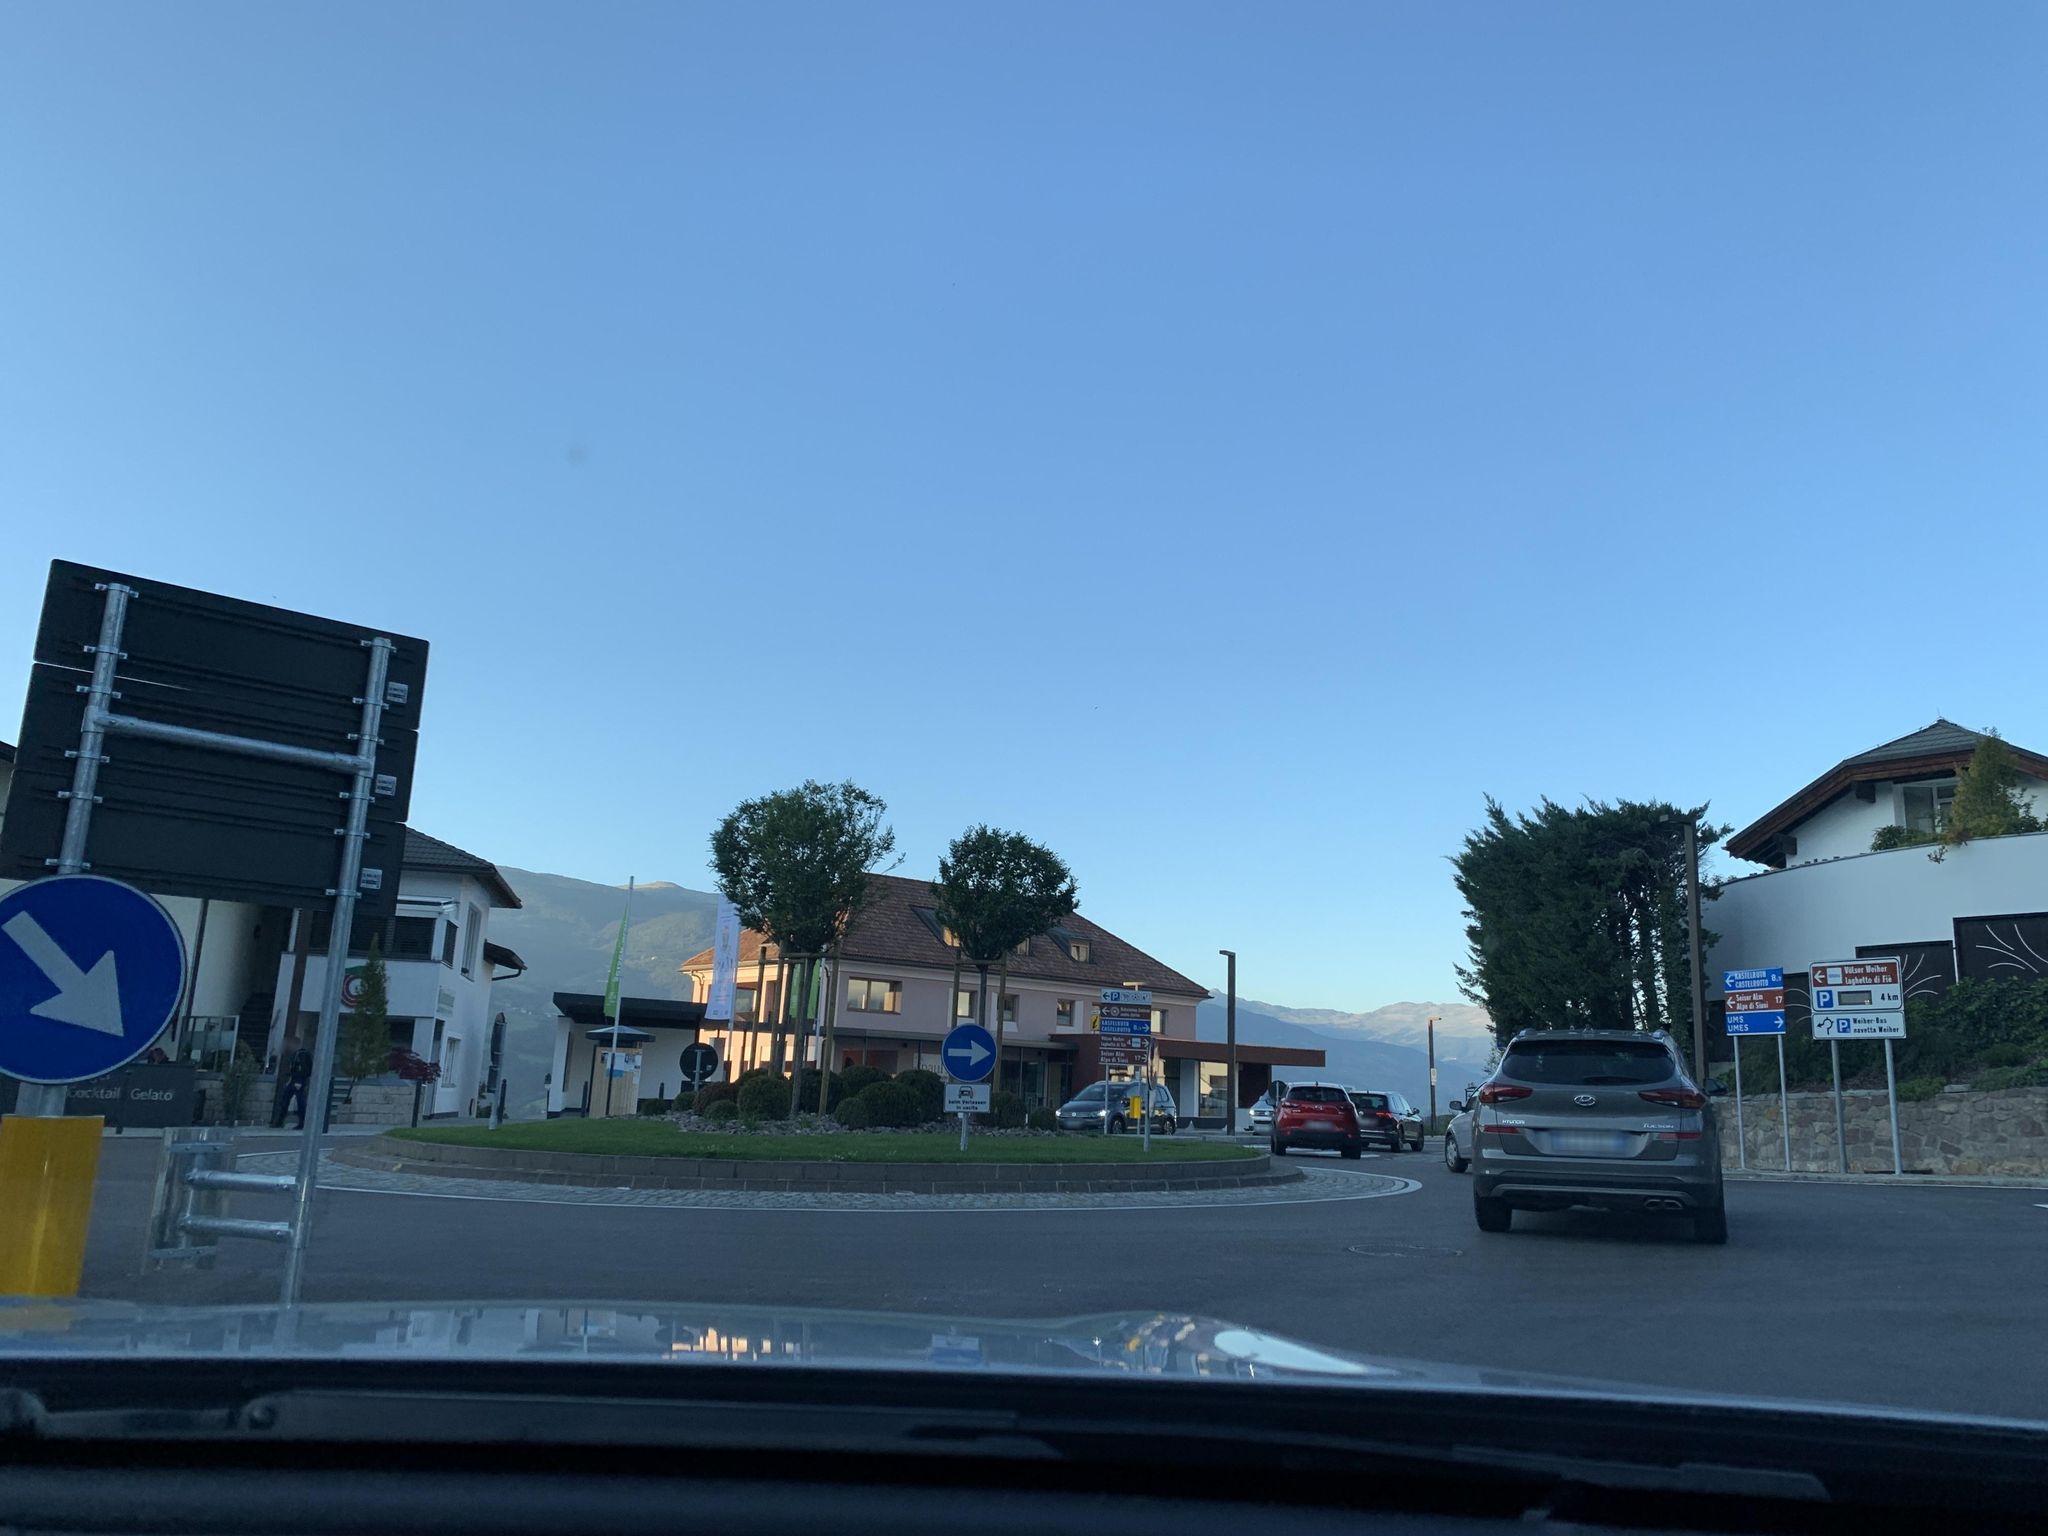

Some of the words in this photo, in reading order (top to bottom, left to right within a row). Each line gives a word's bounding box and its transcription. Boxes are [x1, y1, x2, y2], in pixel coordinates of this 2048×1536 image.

[1865, 965, 1888, 973] Weiher
[1845, 976, 1872, 986] Laghetto
[1820, 992, 1830, 1006] P
[1888, 992, 1898, 1000] km
[1728, 1016, 1744, 1024] UMS
[1728, 1024, 1748, 1032] UMES
[1838, 1020, 1848, 1032] P
[130, 1088, 173, 1101] Gelato
